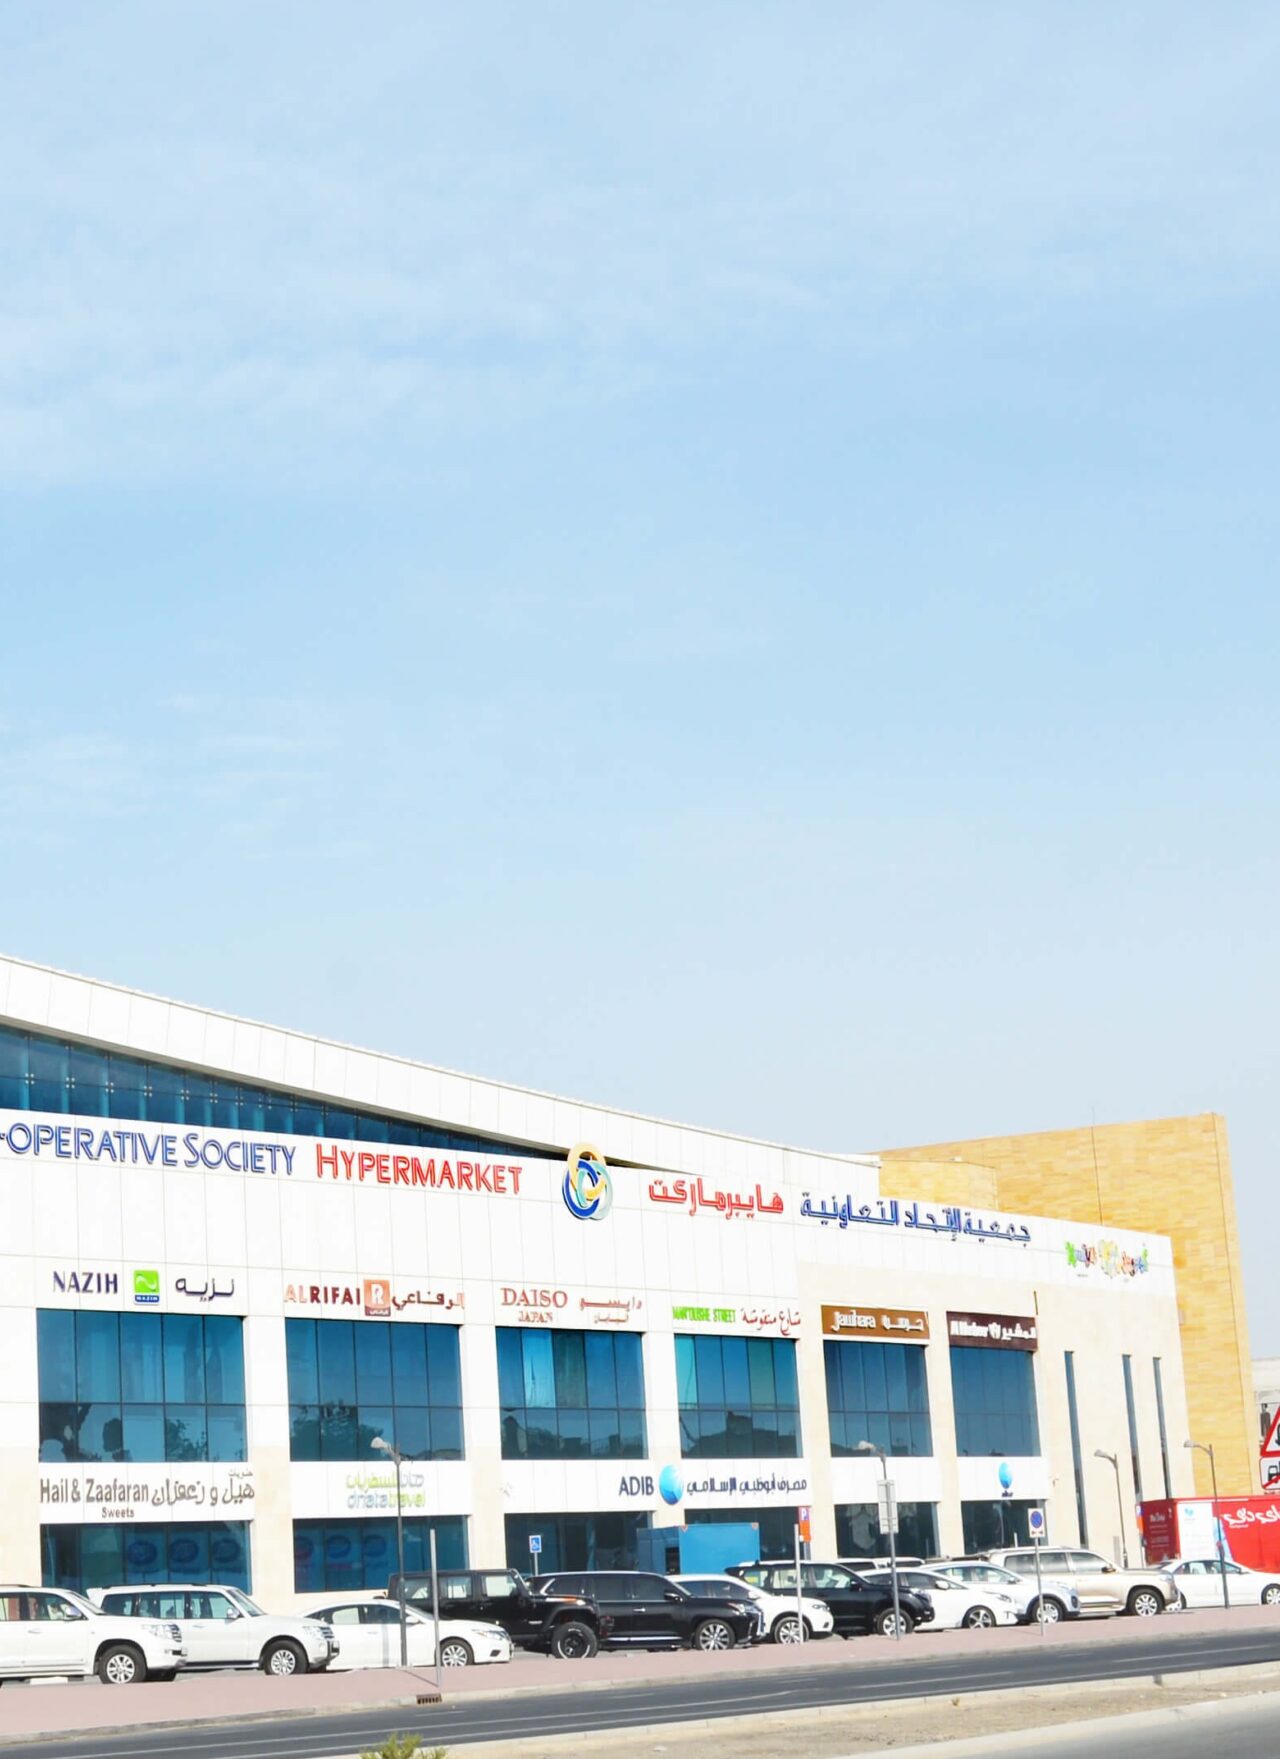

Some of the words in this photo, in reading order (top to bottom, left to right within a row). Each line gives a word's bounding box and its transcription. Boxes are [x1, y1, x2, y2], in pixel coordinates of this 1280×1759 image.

[183, 1132, 296, 1176] SOCIETY
[316, 1143, 523, 1194] HYPERMARKET
[963, 1211, 1032, 1248] جمعية
[53, 1271, 118, 1294] NAZIH
[501, 1288, 568, 1308] DAISO
[519, 1311, 553, 1323] JAPAN
[40, 1478, 69, 1503] Hail
[71, 1480, 81, 1503] &
[86, 1478, 148, 1503] Zaafaran
[151, 1478, 205, 1506] زعفران
[210, 1486, 218, 1506] و
[222, 1477, 255, 1504] هيل
[619, 1476, 654, 1496] ADIB
[102, 1507, 134, 1518] Sweets
